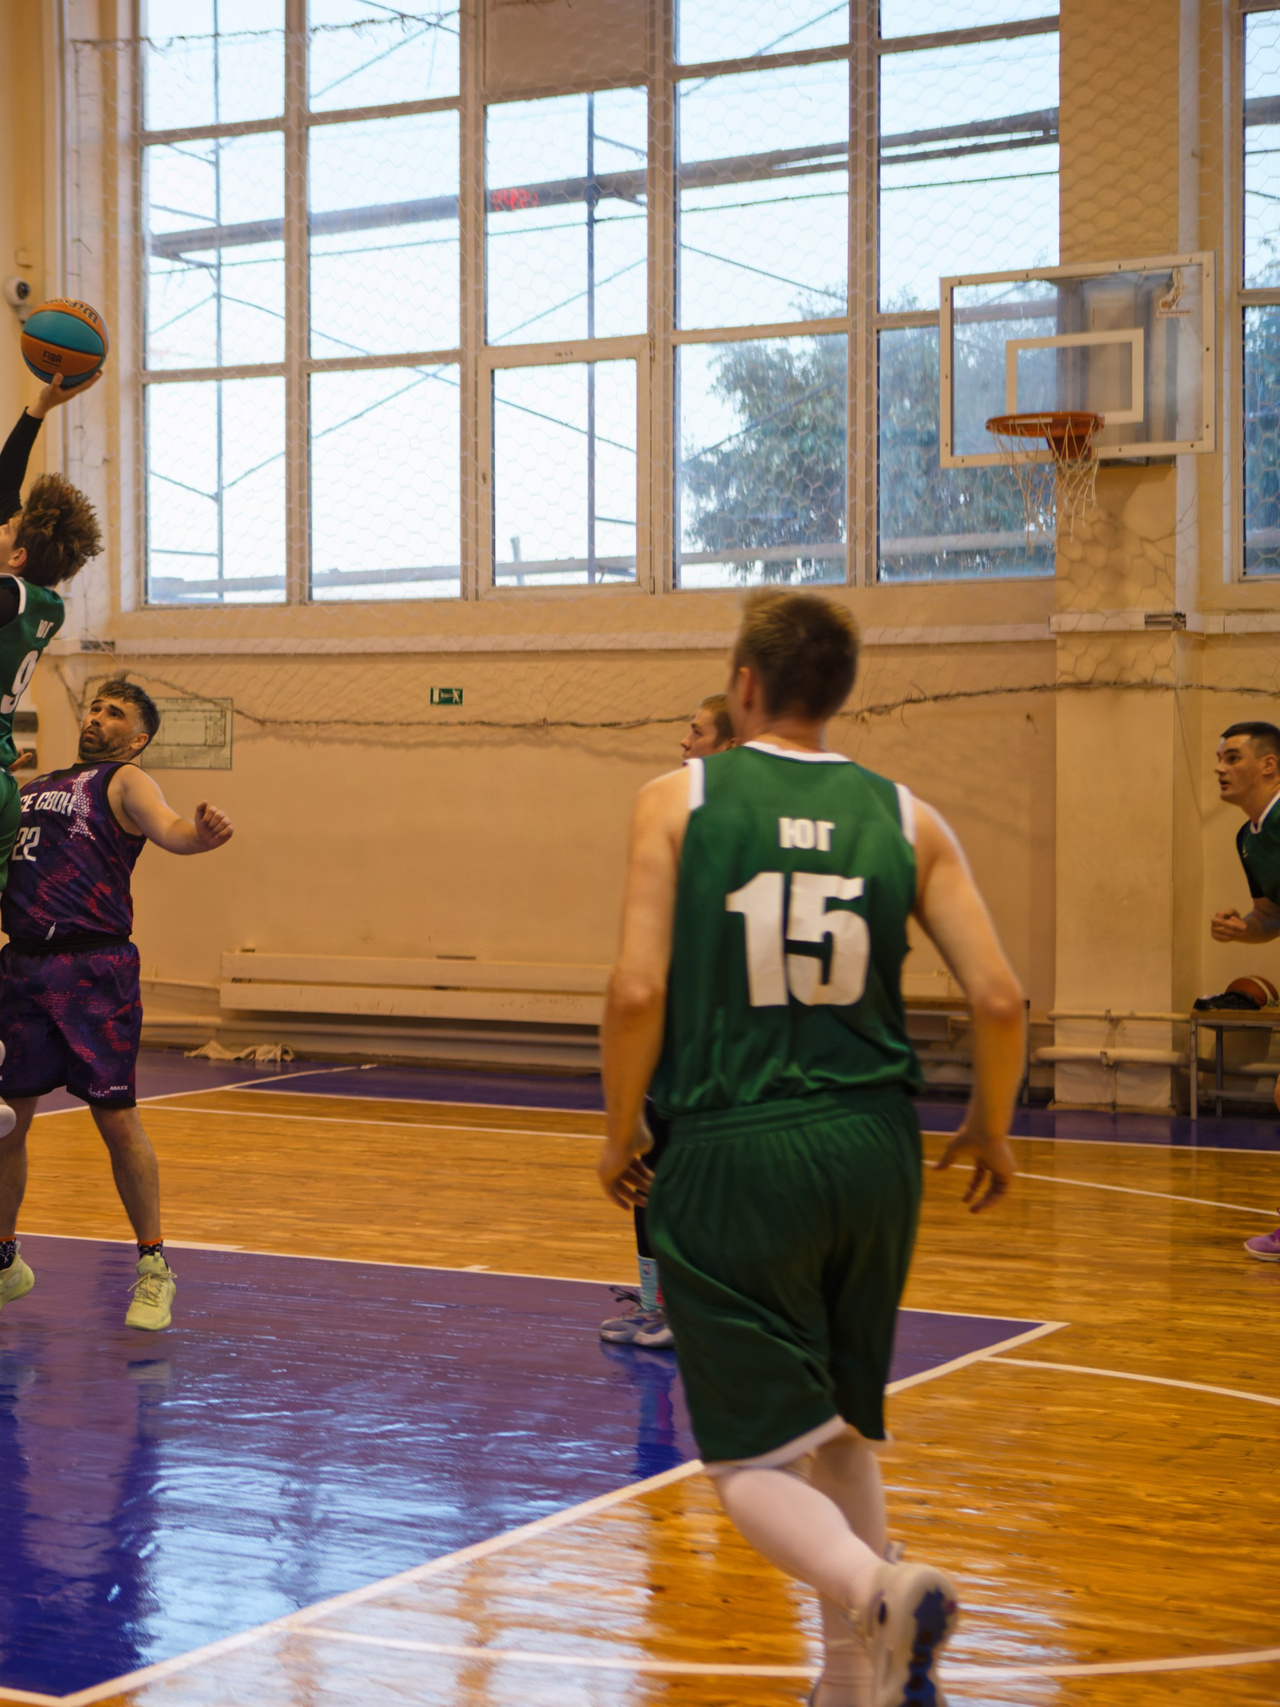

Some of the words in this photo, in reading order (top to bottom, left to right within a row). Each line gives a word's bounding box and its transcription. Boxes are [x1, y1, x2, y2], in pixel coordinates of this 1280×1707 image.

[42, 350, 62, 363] FIBA
[0, 650, 39, 715] 9
[20, 792, 38, 813] СЕ
[11, 826, 41, 862] 22
[778, 816, 836, 852] ЮГ
[725, 871, 871, 1008] 15
